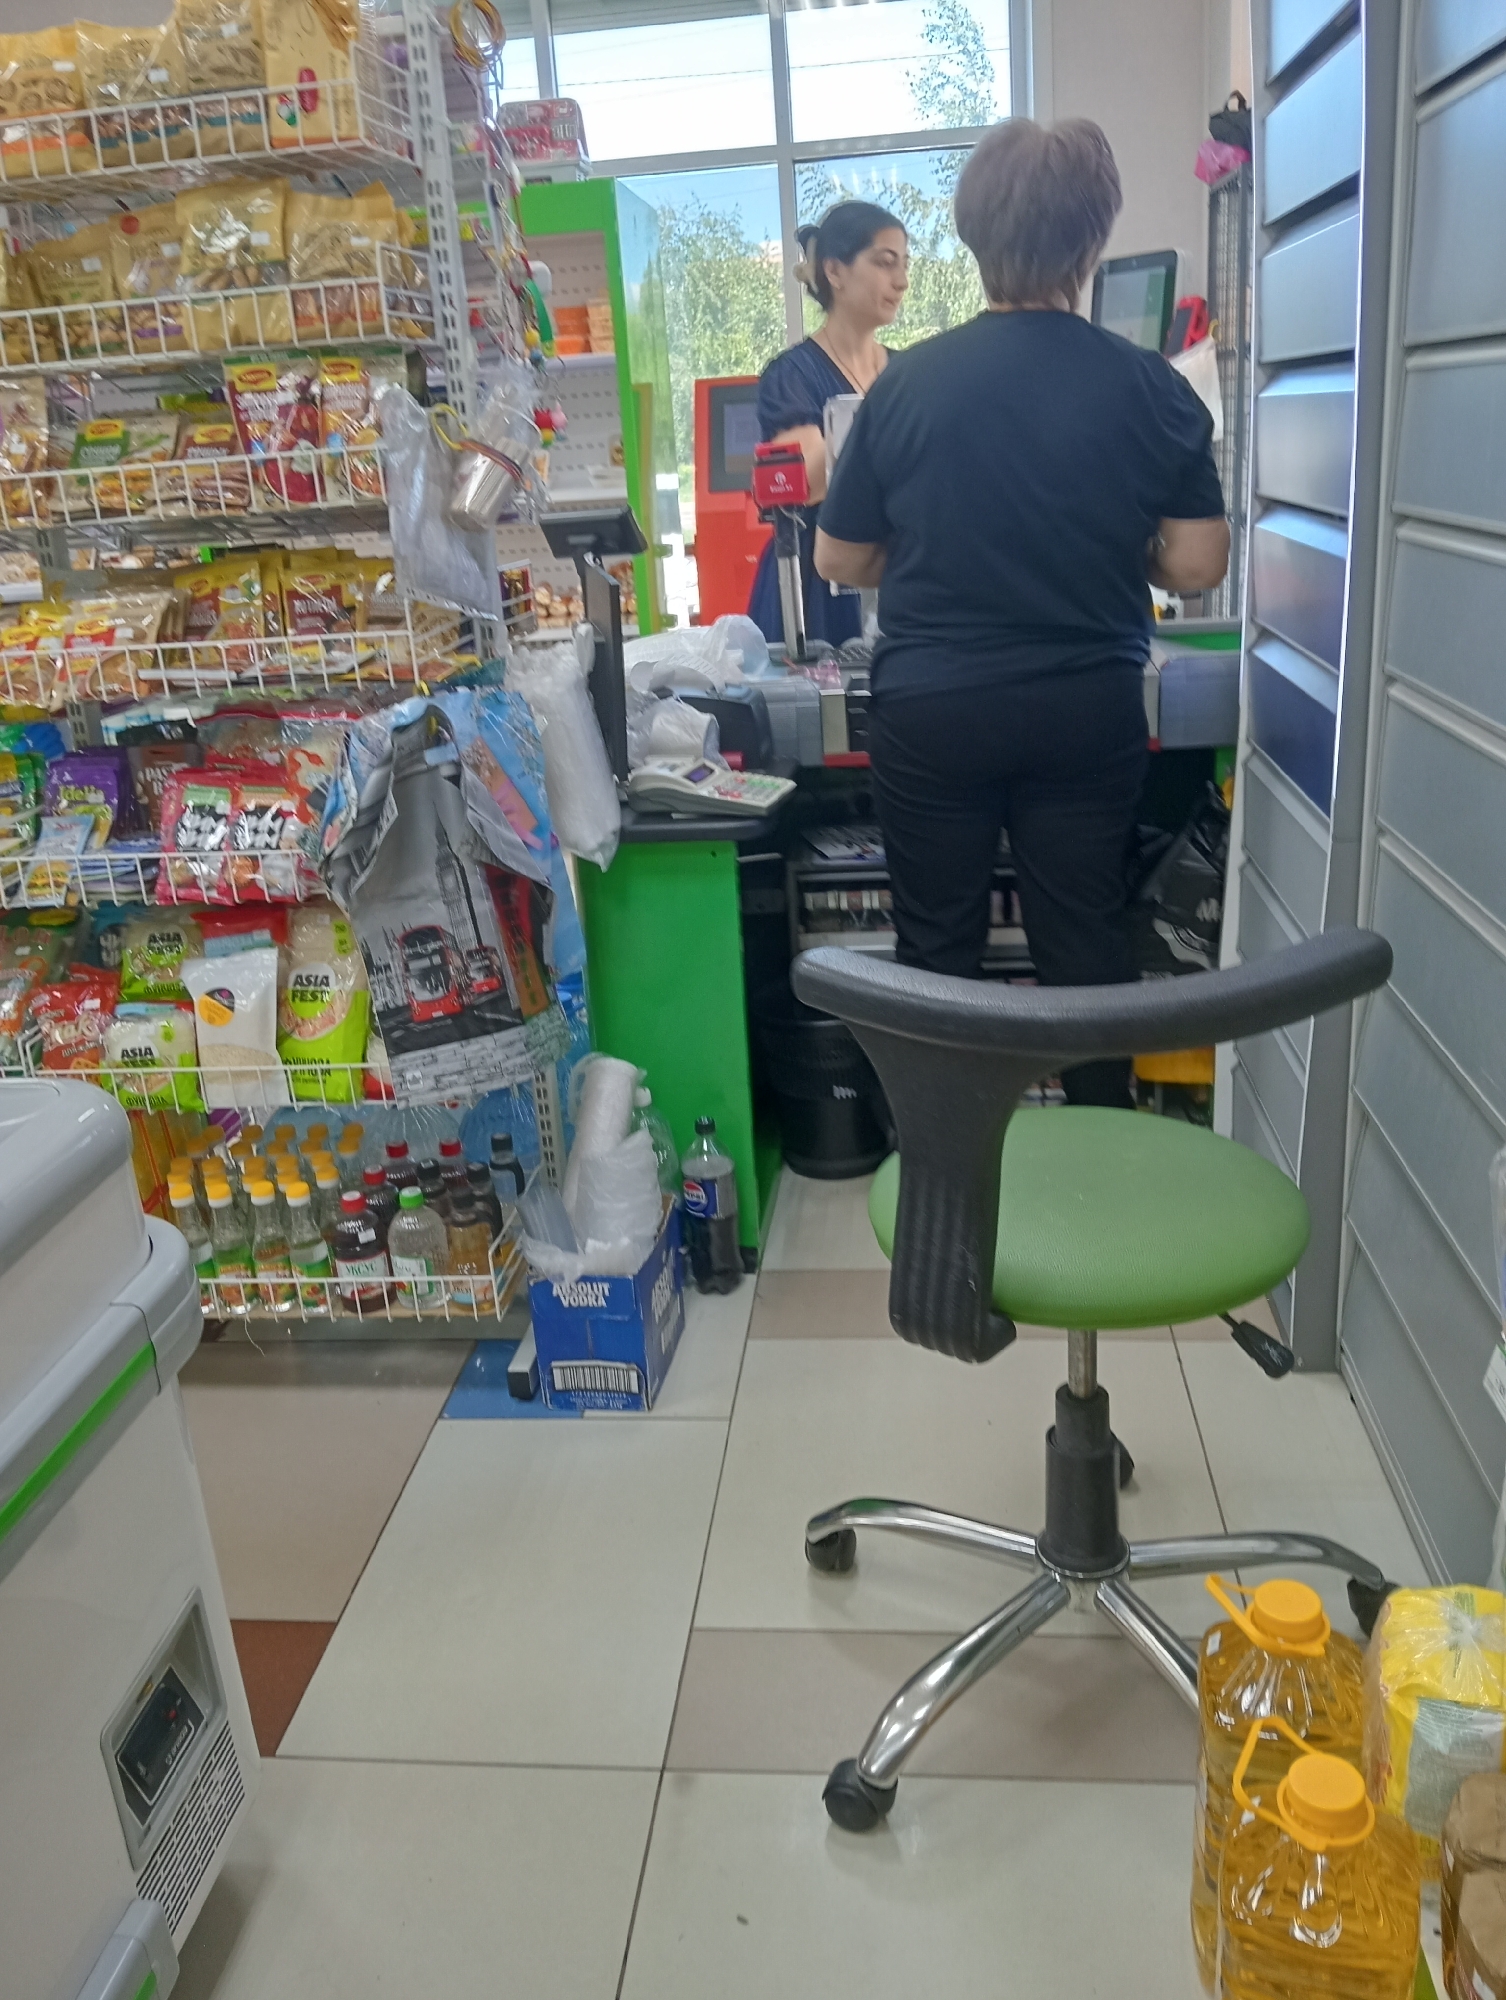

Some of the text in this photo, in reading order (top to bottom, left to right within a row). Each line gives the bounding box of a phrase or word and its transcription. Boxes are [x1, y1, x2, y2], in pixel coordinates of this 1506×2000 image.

[294, 974, 330, 987] ASIA
[292, 989, 331, 1002] FEST
[121, 1047, 155, 1059] ASIA
[552, 1281, 610, 1297] ABSOLUT
[558, 1295, 608, 1308] VODKA
